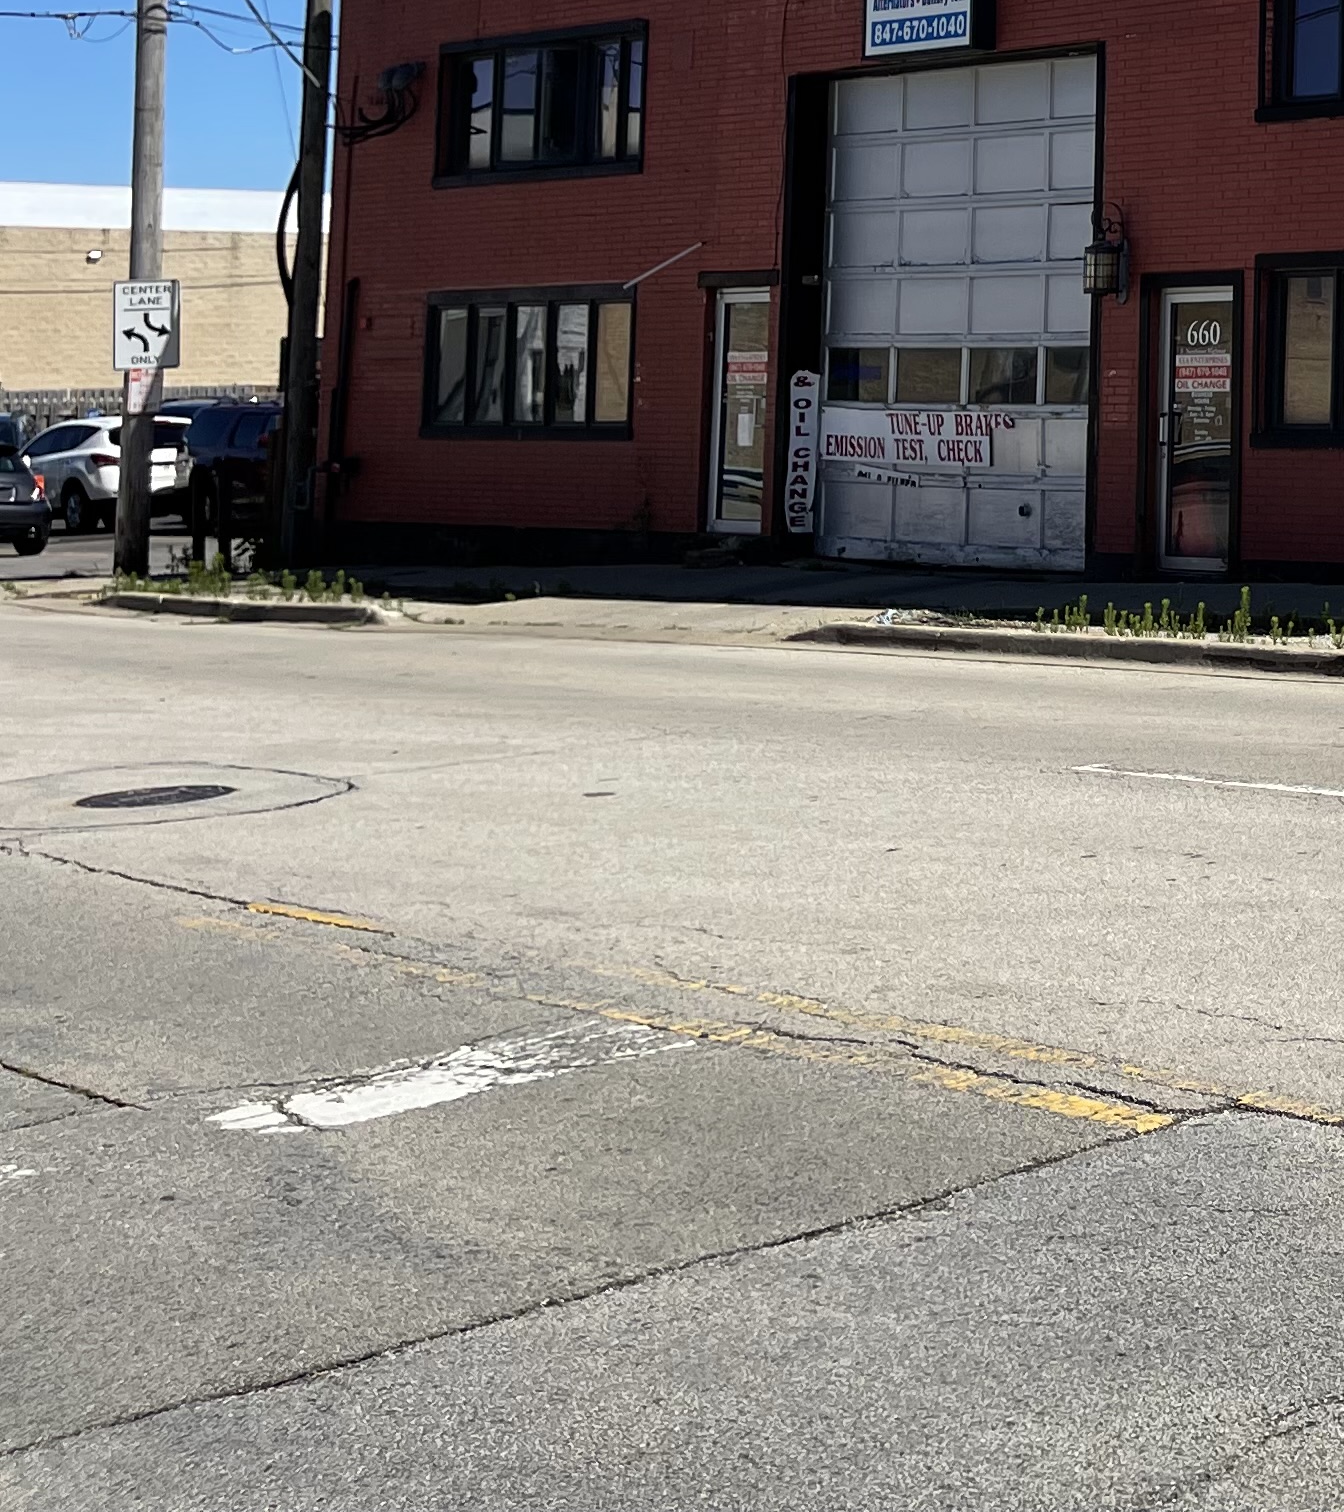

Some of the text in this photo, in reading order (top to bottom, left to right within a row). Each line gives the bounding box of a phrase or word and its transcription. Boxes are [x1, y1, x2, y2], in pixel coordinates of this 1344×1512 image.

[874, 14, 965, 44] 847-670-1040
[122, 285, 172, 296] CENTER
[129, 297, 163, 307] LANE
[1187, 320, 1221, 346] 660
[131, 355, 160, 365] ONLY
[1176, 380, 1227, 390] OIL CHANGE
[886, 413, 944, 435] TUNE-UP
[788, 376, 815, 527] & OIL CHANGE
[826, 434, 983, 464] EMISSION TEST, CHECK
